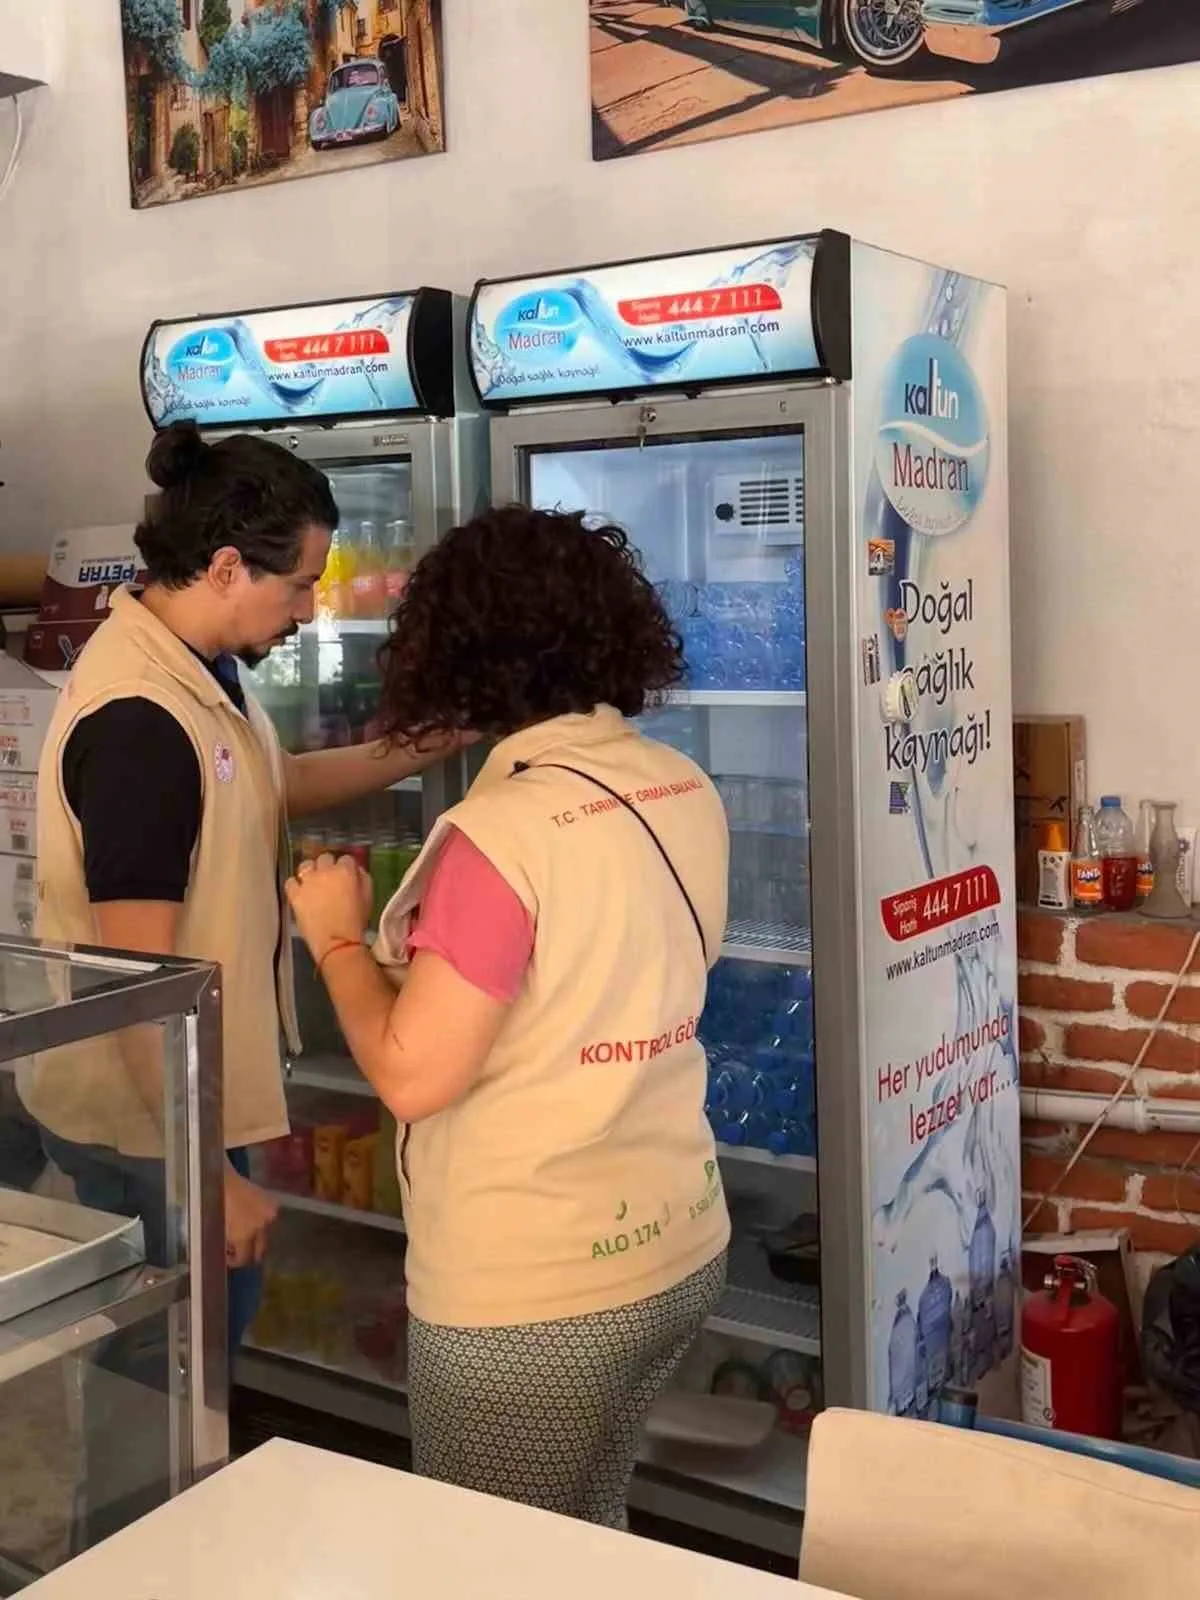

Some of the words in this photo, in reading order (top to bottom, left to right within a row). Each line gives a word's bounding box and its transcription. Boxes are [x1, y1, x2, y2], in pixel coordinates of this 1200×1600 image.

[667, 297, 703, 316] 444
[711, 294, 721, 311] 7
[731, 288, 762, 308] 111
[303, 336, 329, 354] 444
[335, 335, 344, 353] 7
[350, 333, 376, 352] 111
[509, 330, 566, 350] Madran
[623, 320, 779, 347] www.kaltunmadran.com
[893, 441, 969, 491] Madran
[78, 564, 135, 583] PETRA
[900, 578, 973, 634] Doğal
[902, 648, 975, 705] ağlık
[885, 710, 991, 772] kaynağı!
[923, 887, 949, 920] 444
[953, 882, 961, 910] 7
[966, 873, 988, 905] 111
[886, 922, 1000, 980] www.kaltunmadran.com
[580, 1031, 672, 1065] KONTROL
[878, 1063, 910, 1104] Her
[915, 1006, 1009, 1092] yudumunda
[910, 1083, 964, 1144] lezzet
[592, 1234, 629, 1259] ALO
[634, 1220, 661, 1246] 174
